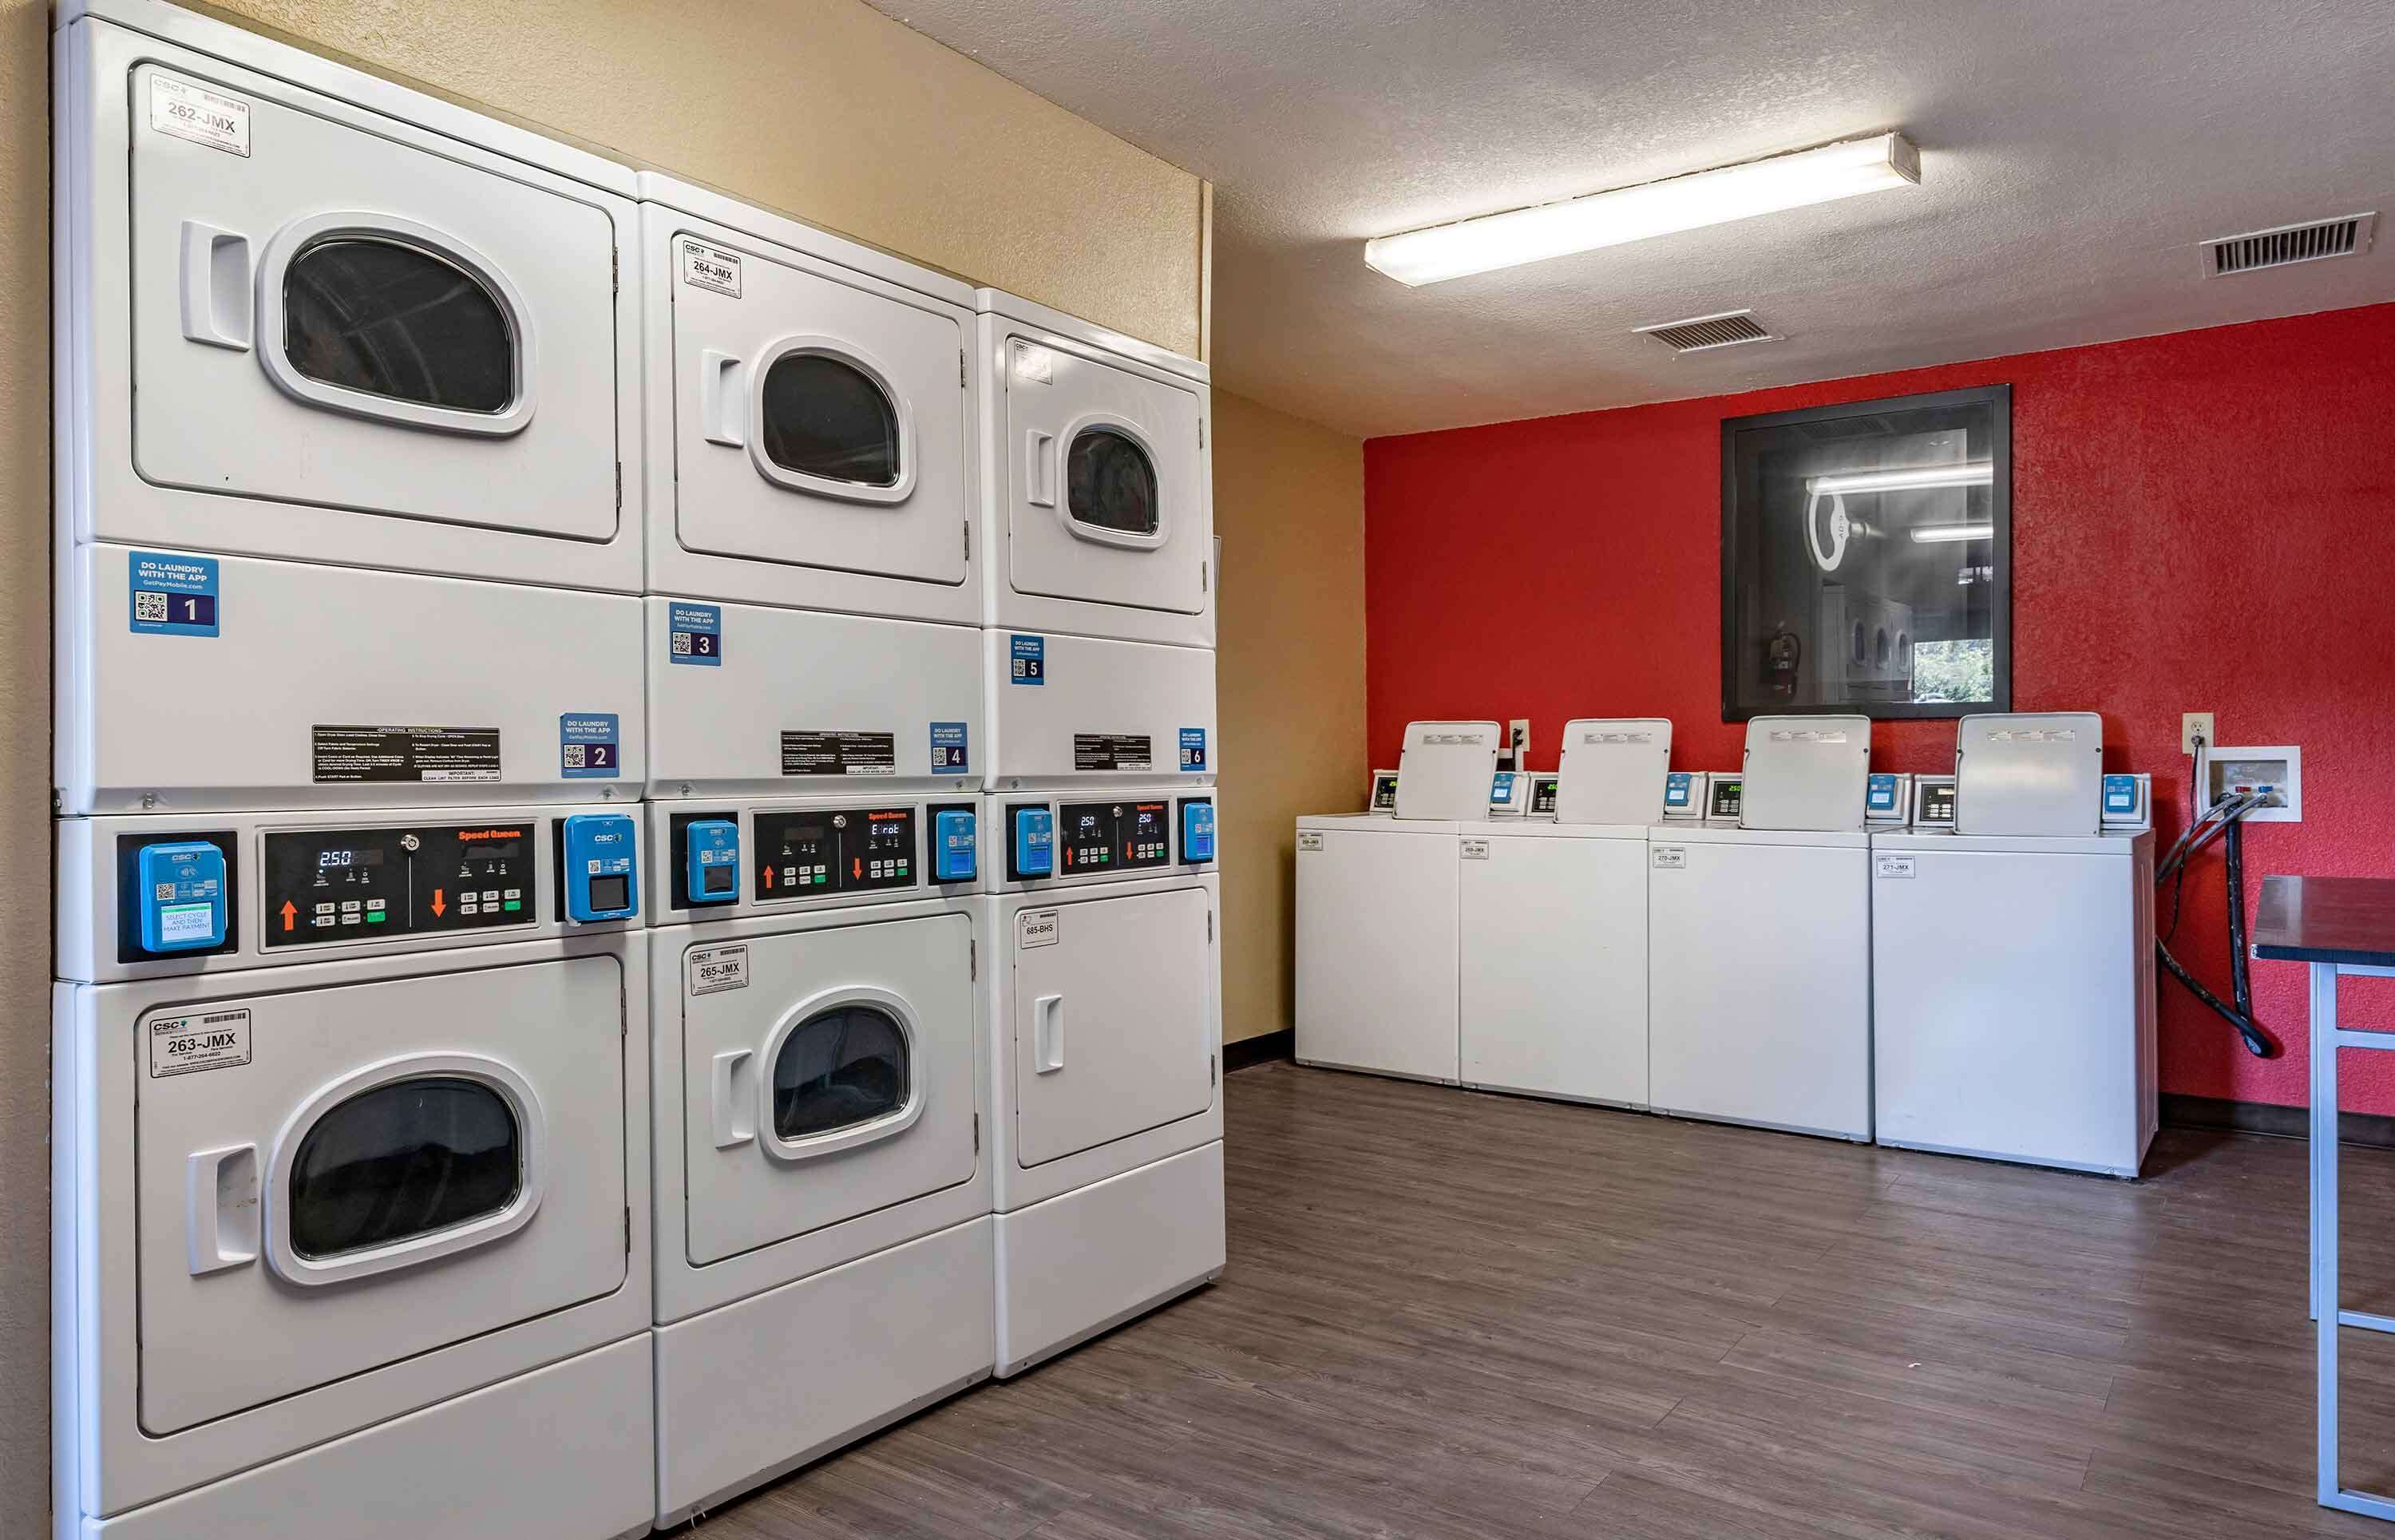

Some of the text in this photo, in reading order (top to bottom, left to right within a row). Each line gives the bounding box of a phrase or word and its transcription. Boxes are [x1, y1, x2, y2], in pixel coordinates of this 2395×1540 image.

[168, 101, 235, 133] 262-JMX
[685, 244, 700, 253] CSC
[694, 260, 732, 280] 264-JMX
[138, 569, 164, 579] WITH
[167, 572, 186, 580] THE
[158, 563, 204, 574] LAUNDRY
[143, 580, 204, 590] GetPayMobile.com
[184, 599, 196, 620] 1
[699, 636, 710, 654] 3
[1030, 662, 1037, 675] 5
[594, 747, 607, 765] 2
[952, 749, 960, 763] 4
[1194, 750, 1201, 762] 6
[459, 830, 521, 841] Speed Queen
[320, 851, 351, 866] 2.50
[1027, 924, 1053, 935] 685-BHS
[700, 962, 740, 978] 265-JMX
[153, 1021, 180, 1031] CSC
[168, 1032, 236, 1054] 263-JMX
